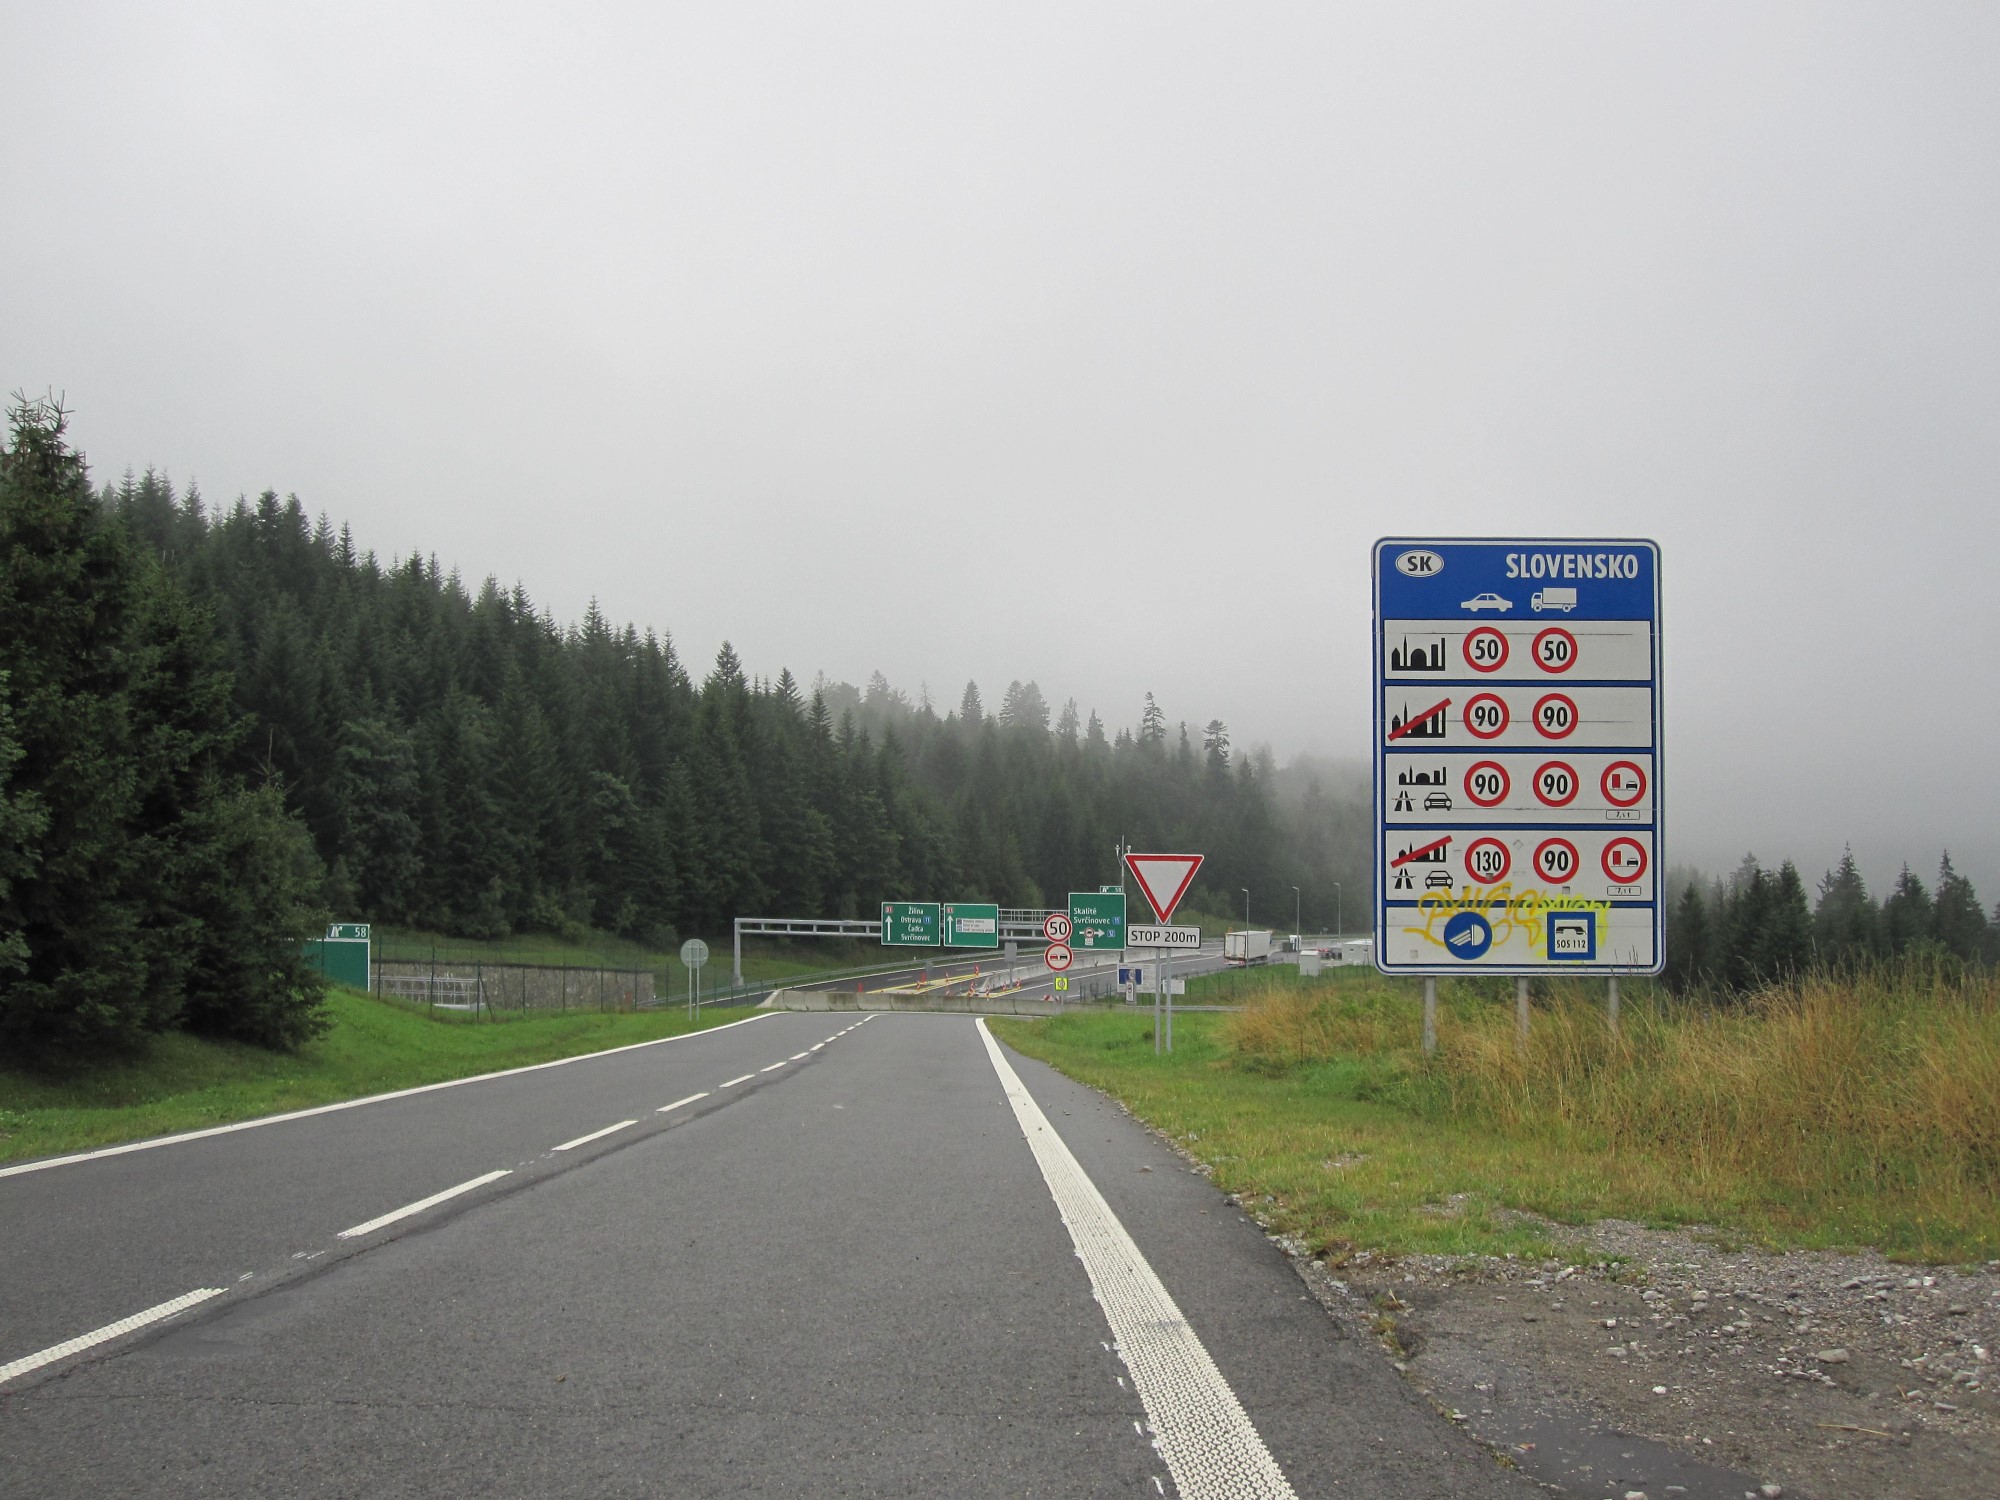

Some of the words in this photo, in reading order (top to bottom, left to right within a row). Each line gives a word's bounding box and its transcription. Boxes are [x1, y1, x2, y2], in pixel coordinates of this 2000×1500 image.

[1407, 555, 1433, 572] SK
[1505, 553, 1638, 579] SLOVENSKO
[1474, 639, 1499, 660] 50
[1543, 640, 1568, 662] 50
[1474, 706, 1499, 727] 90
[1543, 706, 1568, 727] 90
[1474, 774, 1500, 795] 90
[1543, 774, 1569, 795] 90
[1475, 850, 1501, 872] 130
[1544, 850, 1569, 872] 90
[908, 906, 923, 915] Žilina
[1073, 907, 1097, 915] Skalité
[900, 916, 922, 924] Ostrava
[1073, 917, 1110, 925] Svrčinovec
[355, 927, 366, 937] 58
[908, 924, 923, 932] Čadca
[1049, 921, 1068, 936] 50
[901, 933, 930, 941] Svrčinovec
[1131, 930, 1161, 942] STOP
[1164, 931, 1197, 943] 200m
[1556, 940, 1571, 949] SOS
[1573, 940, 1587, 949] 112
